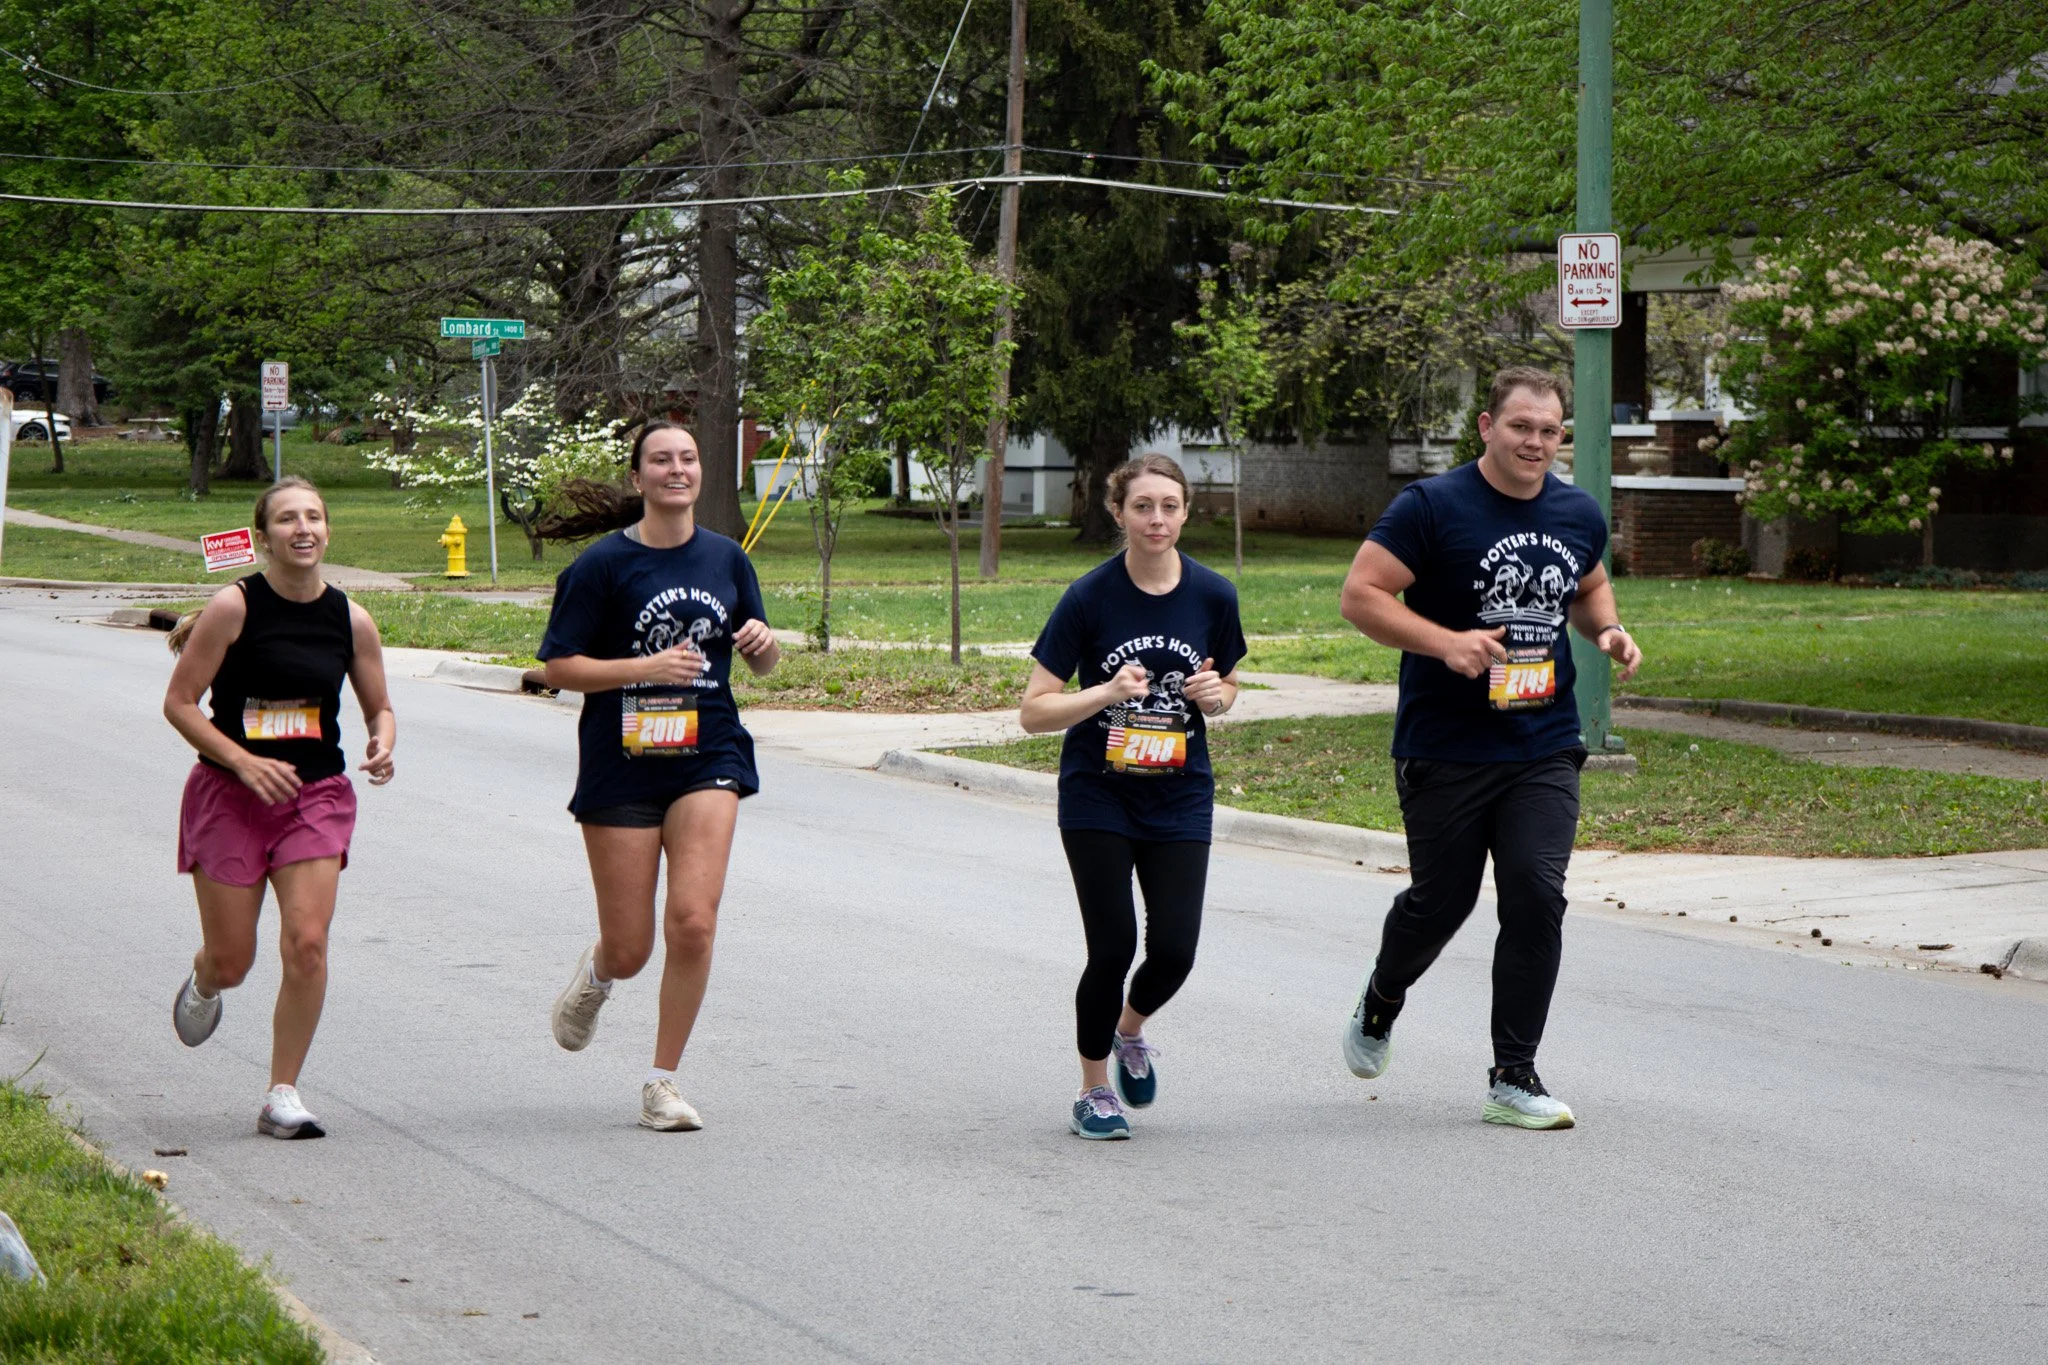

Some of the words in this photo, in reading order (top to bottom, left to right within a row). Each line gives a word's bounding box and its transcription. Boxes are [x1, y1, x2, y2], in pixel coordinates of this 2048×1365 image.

[1578, 243, 1600, 260] NO
[1563, 262, 1615, 280] PARKING
[442, 320, 492, 335] Lombard
[492, 327, 499, 336] St
[503, 325, 518, 333] 1400
[263, 376, 287, 386] PARKING
[270, 365, 280, 376] NO
[1479, 532, 1538, 572] POTTER'S
[1542, 533, 1579, 575] HOUSE
[634, 587, 687, 632] POTTER'S
[691, 588, 728, 624] HOUSE
[1101, 636, 1165, 674] POTTER'S
[1168, 638, 1203, 671] HOUS
[1505, 667, 1550, 695] 2149
[261, 712, 307, 736] 2014
[639, 716, 687, 743] 2018
[1123, 733, 1177, 763] 2148
